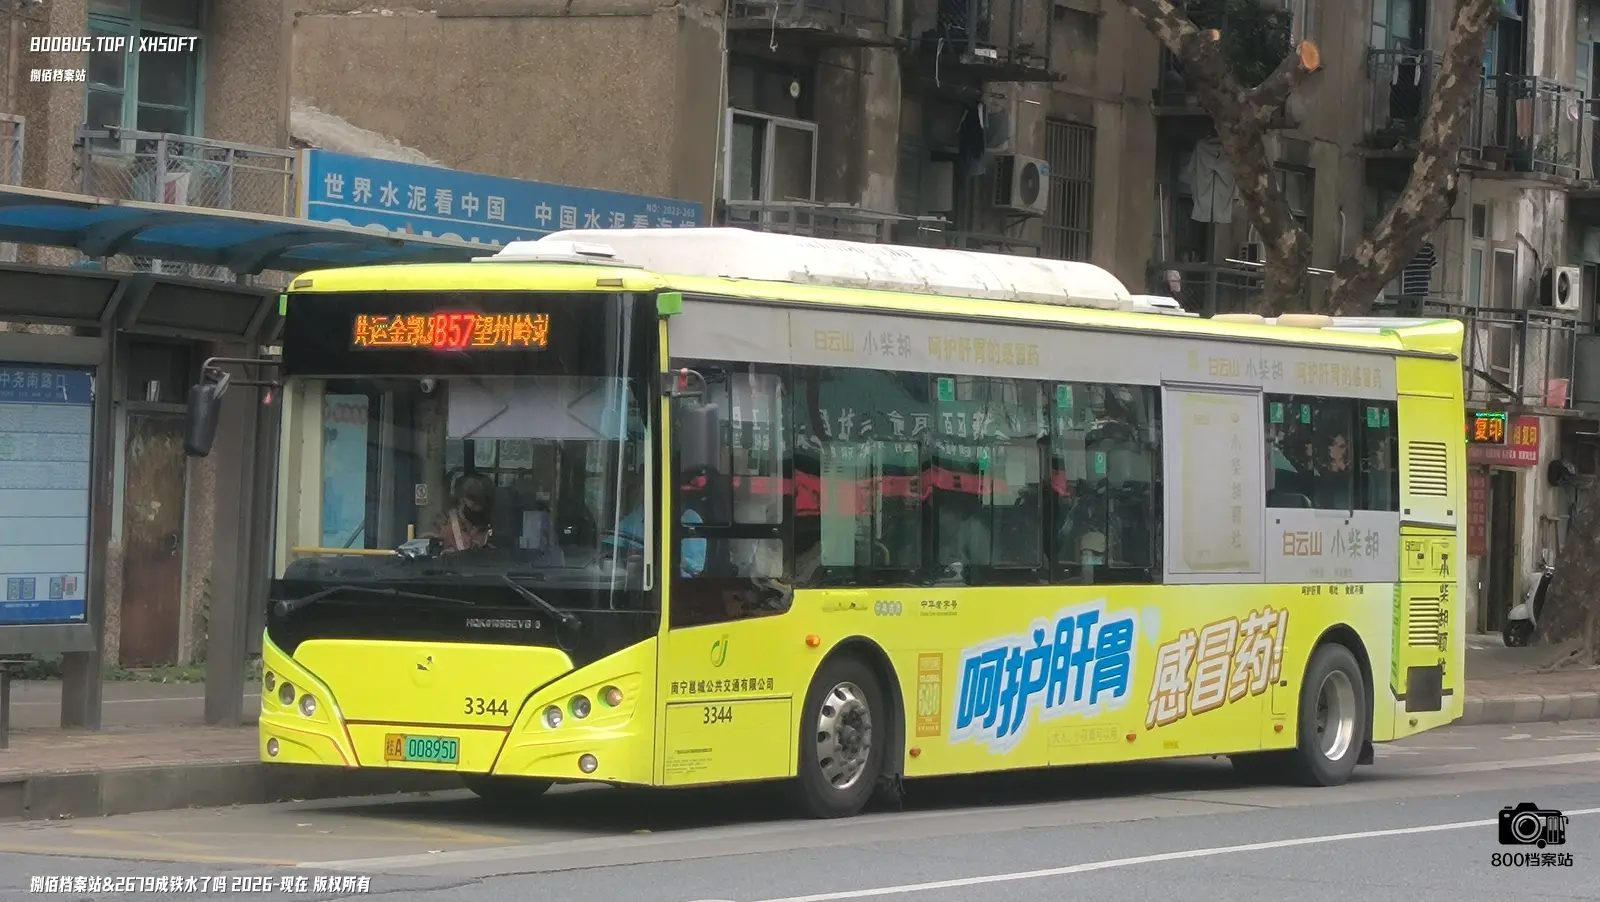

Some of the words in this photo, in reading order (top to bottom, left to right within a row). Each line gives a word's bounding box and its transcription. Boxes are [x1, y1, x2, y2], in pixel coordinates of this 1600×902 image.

[324, 172, 505, 222] 世界水泥看中国
[814, 329, 854, 352] 白云山
[863, 330, 912, 358] 小柴胡
[0, 370, 66, 389] 中尧南路口
[1208, 357, 1239, 377] 白云山
[1246, 358, 1283, 380] 小柴胡
[1475, 418, 1503, 441] 复印
[1282, 530, 1322, 557] 白云山
[1331, 528, 1379, 560] 小柴胡
[956, 609, 1134, 738] 呵护肝胃
[1146, 605, 1289, 731] 感冒药!
[671, 678, 774, 695] 南宁邕城公共交通有限公司
[464, 697, 508, 716] 3344
[703, 706, 733, 724] 3344
[409, 739, 457, 759] 00895D
